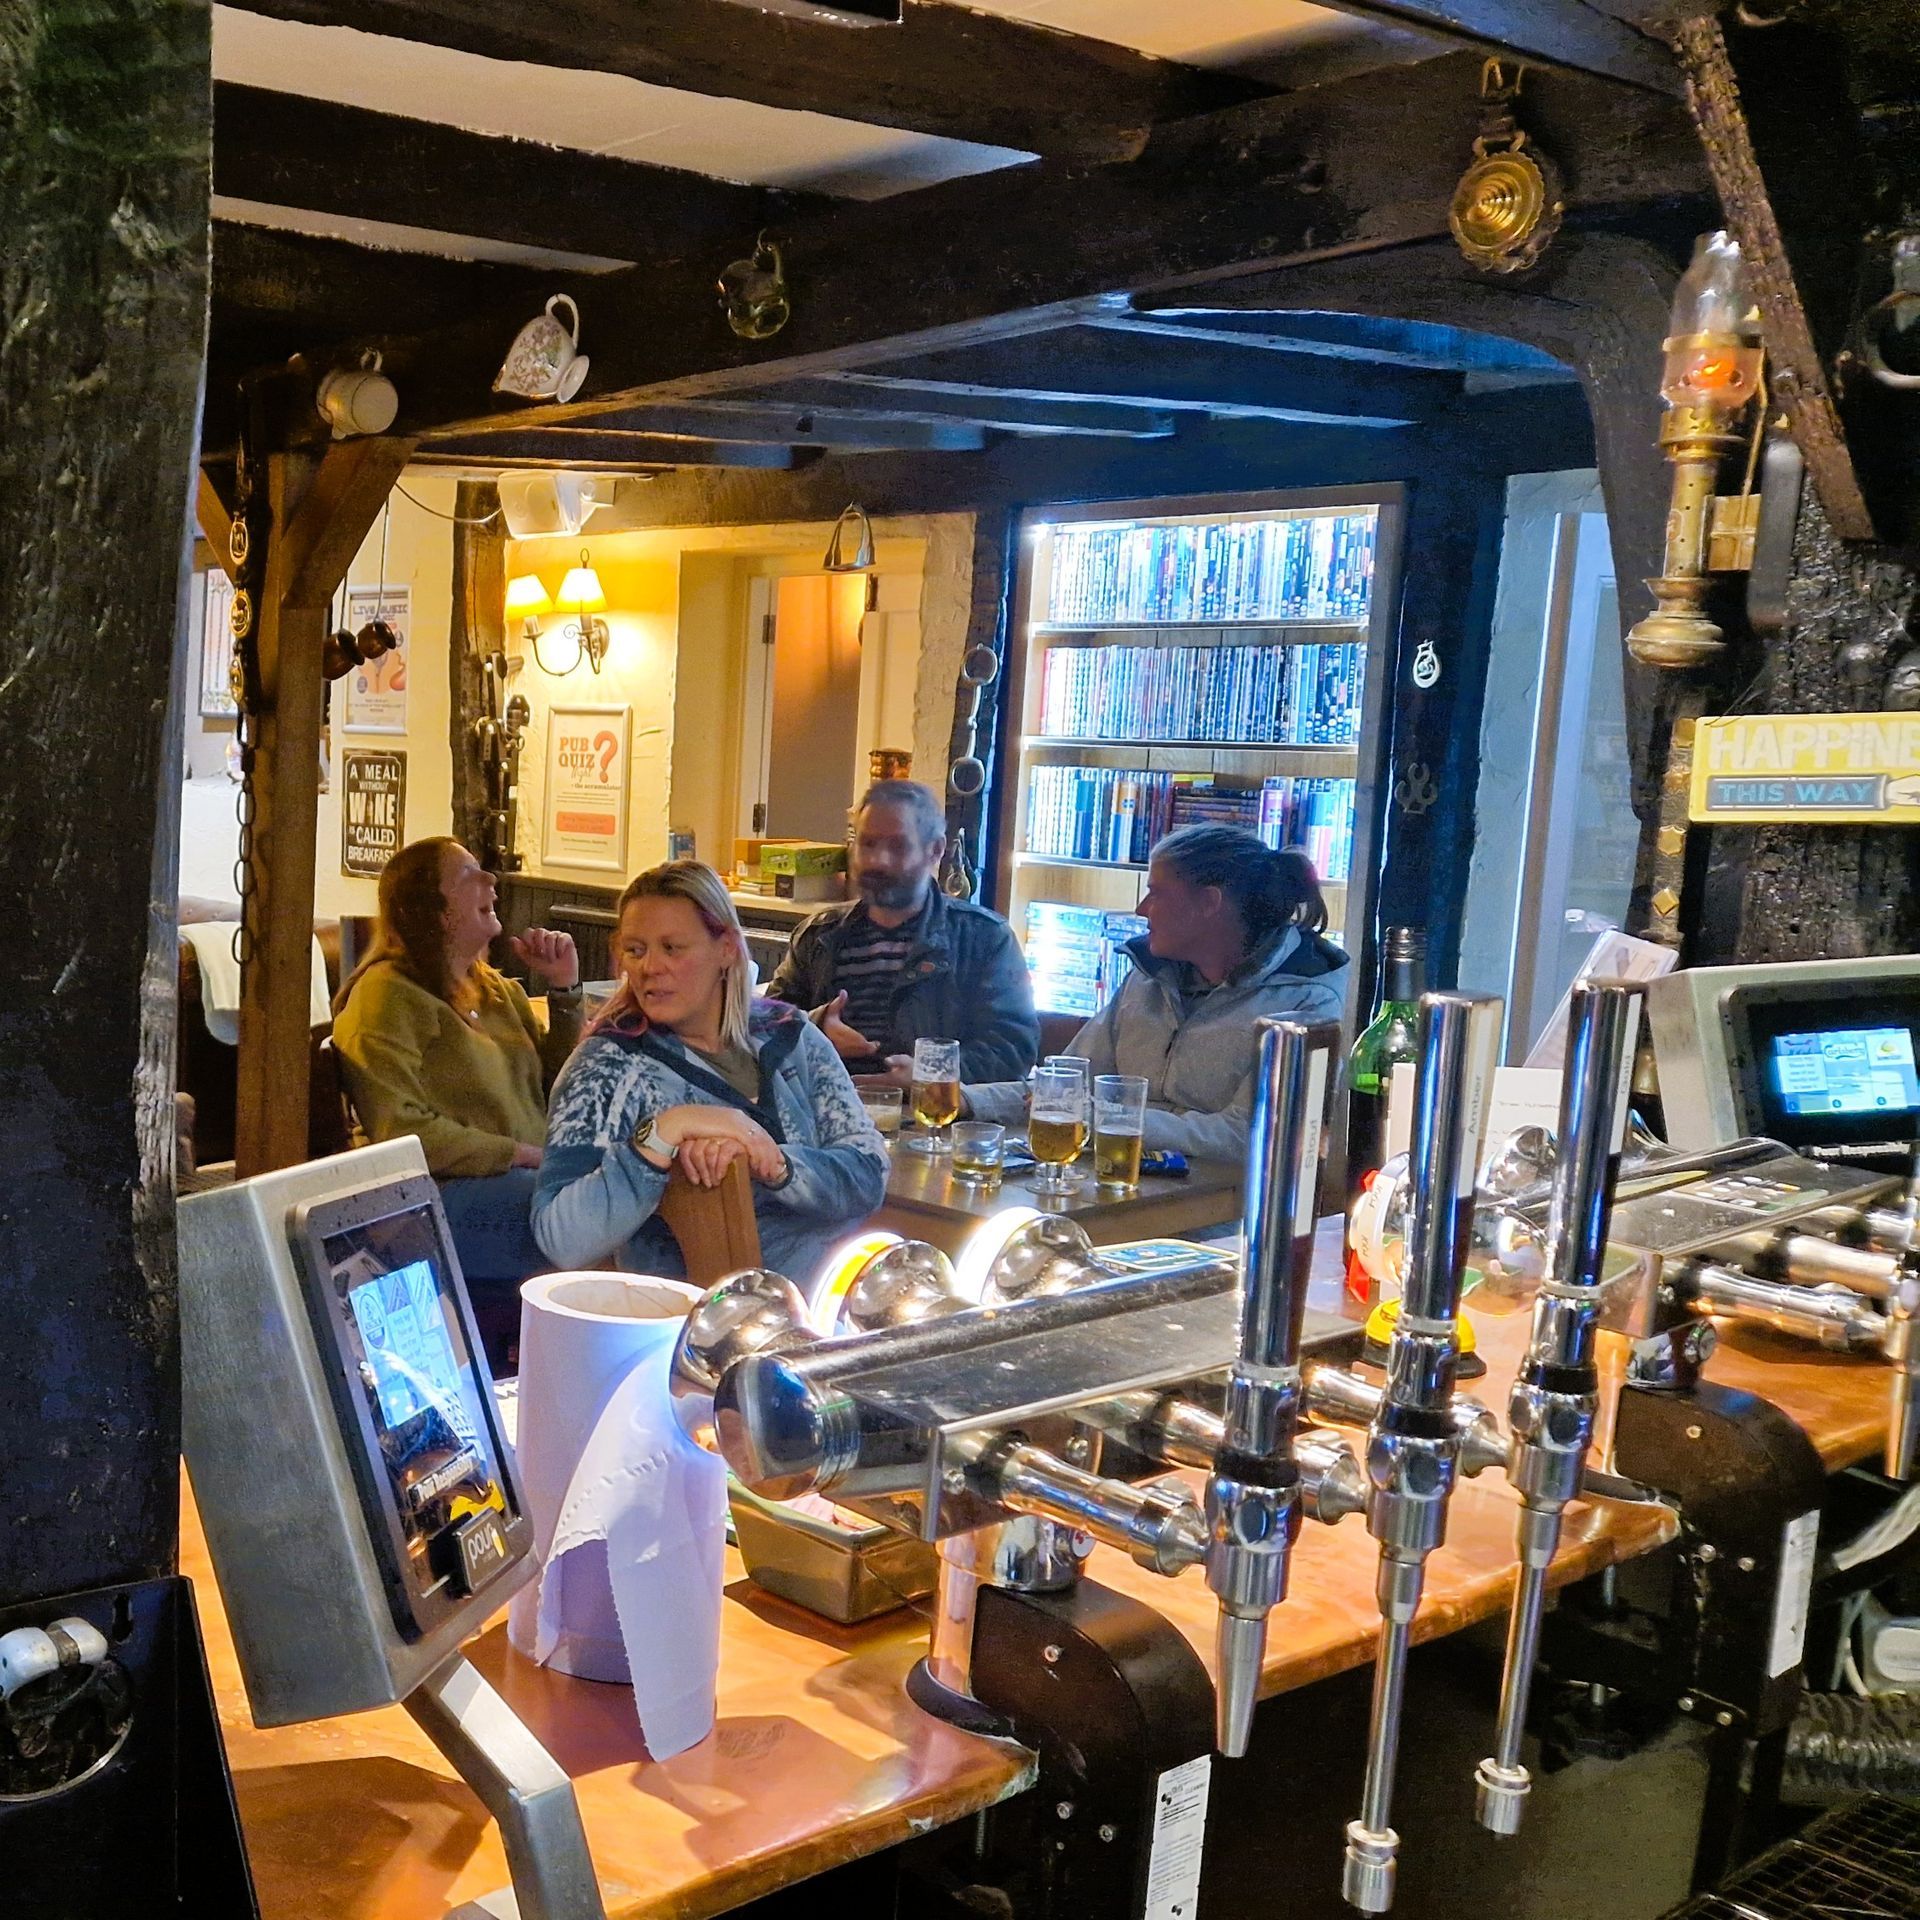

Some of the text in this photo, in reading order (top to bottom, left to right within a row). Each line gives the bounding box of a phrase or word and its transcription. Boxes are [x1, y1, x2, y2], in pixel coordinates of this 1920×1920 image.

[559, 736, 589, 752] PUB
[558, 752, 595, 769] QUIZ
[349, 763, 398, 780] A MEAL
[359, 781, 389, 791] WITHOUT
[1718, 783, 1873, 804] THIS WAY
[356, 826, 396, 847] CALLED
[1468, 1075, 1482, 1135] Amber
[1304, 1120, 1318, 1169] Stout
